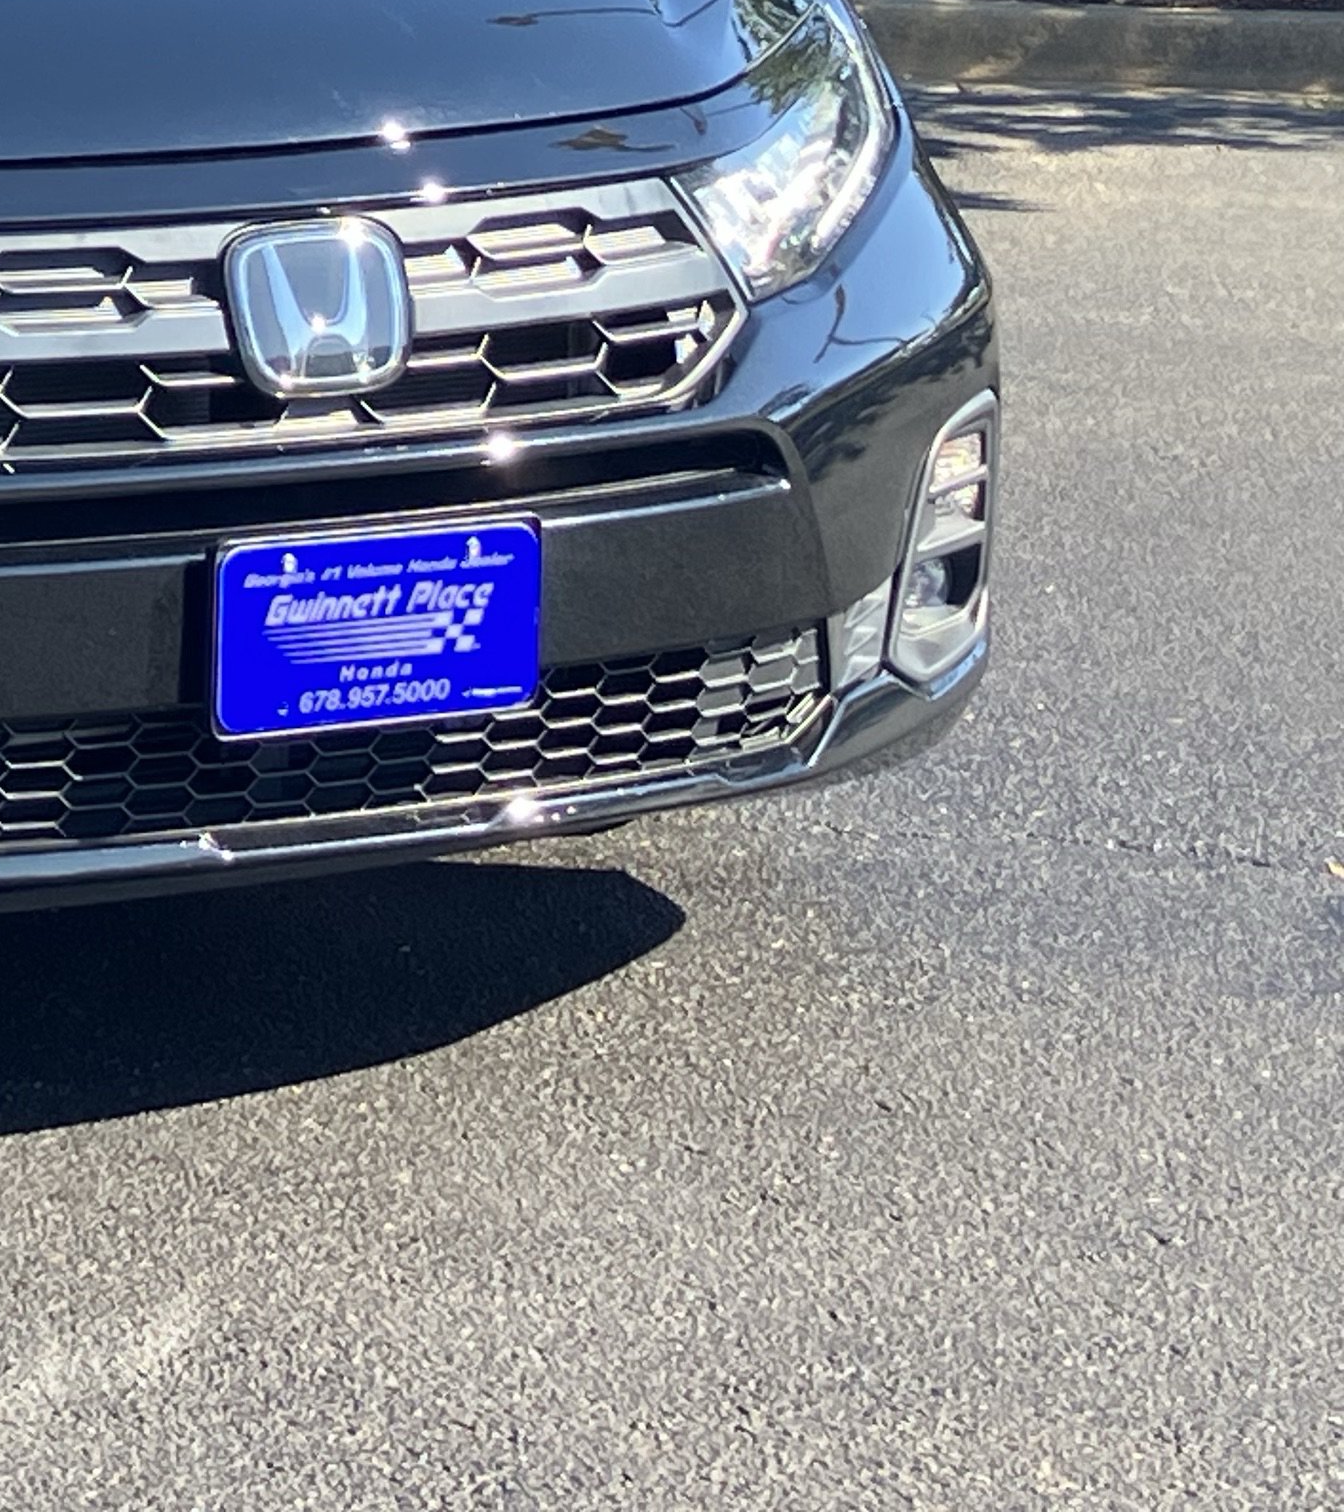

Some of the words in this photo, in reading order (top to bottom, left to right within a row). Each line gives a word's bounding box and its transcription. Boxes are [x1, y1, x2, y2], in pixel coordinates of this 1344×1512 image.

[264, 584, 402, 626] Gwinnett
[405, 579, 495, 613] Place
[339, 659, 413, 683] Honda
[298, 678, 451, 714] 678.957.5000
